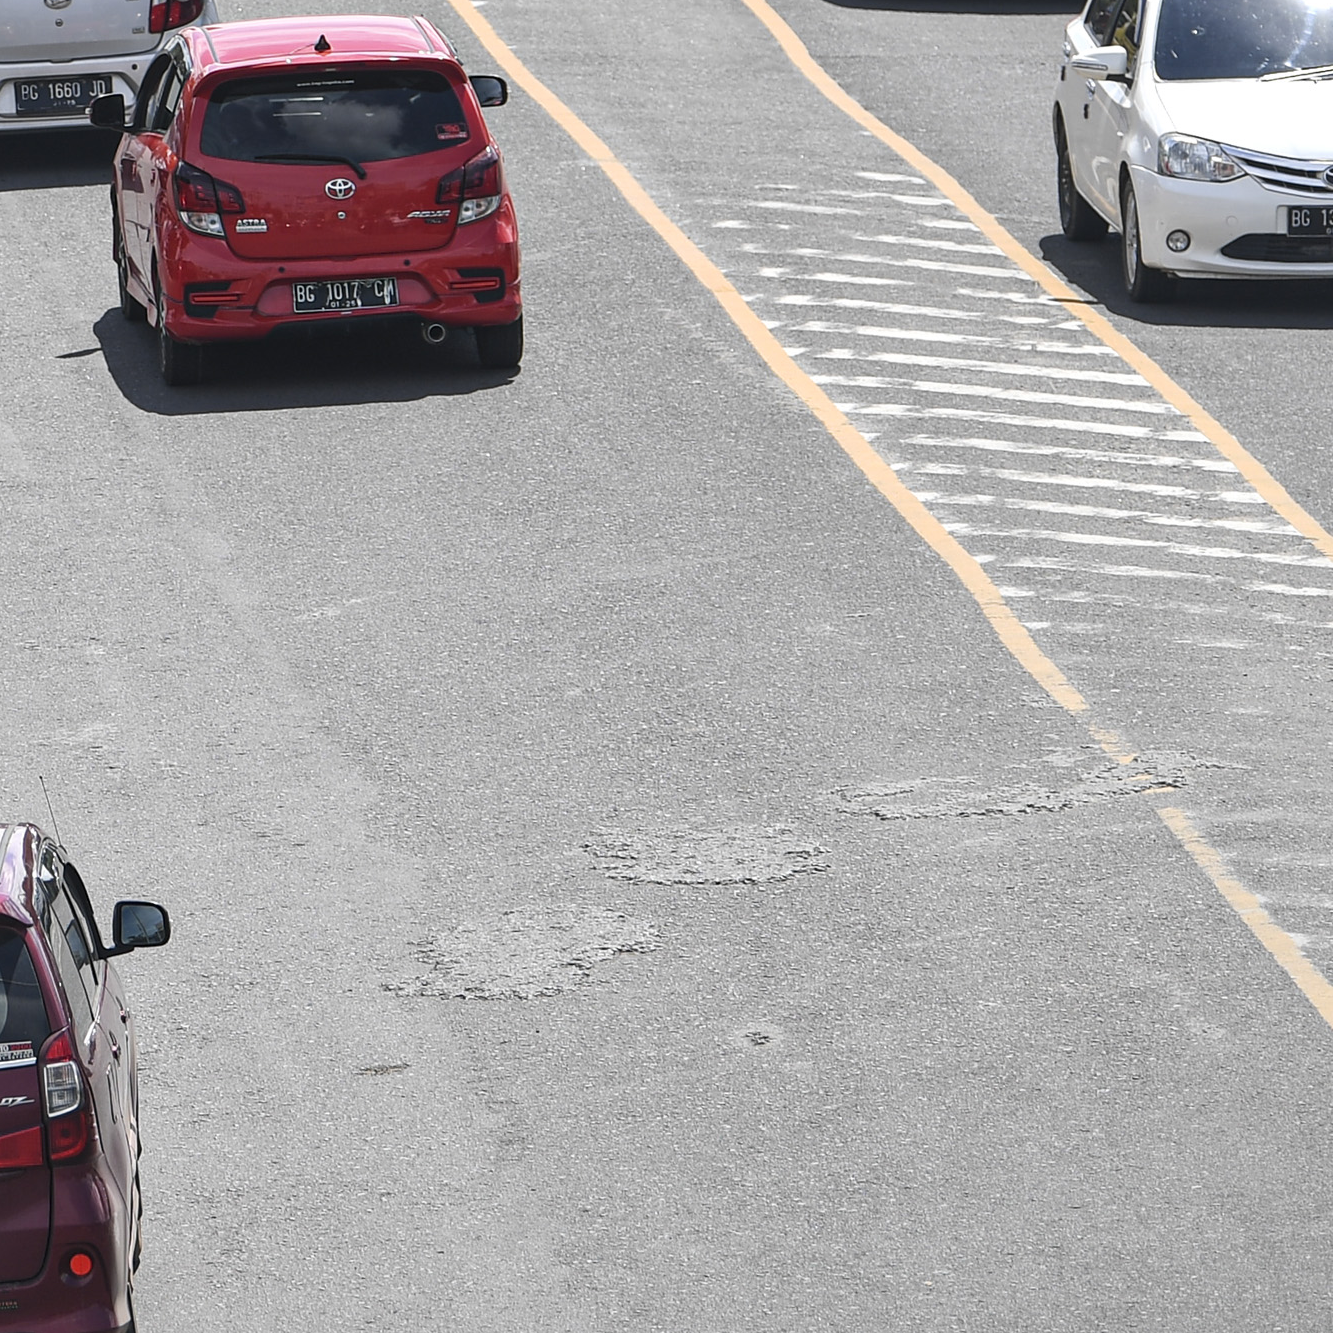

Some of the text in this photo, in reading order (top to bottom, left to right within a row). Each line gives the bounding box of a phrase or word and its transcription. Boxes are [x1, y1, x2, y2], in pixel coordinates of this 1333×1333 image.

[21, 84, 39, 101] BG
[48, 82, 81, 99] 1660
[1291, 209, 1311, 227] BG
[296, 285, 316, 303] BG
[326, 282, 359, 301] 1017
